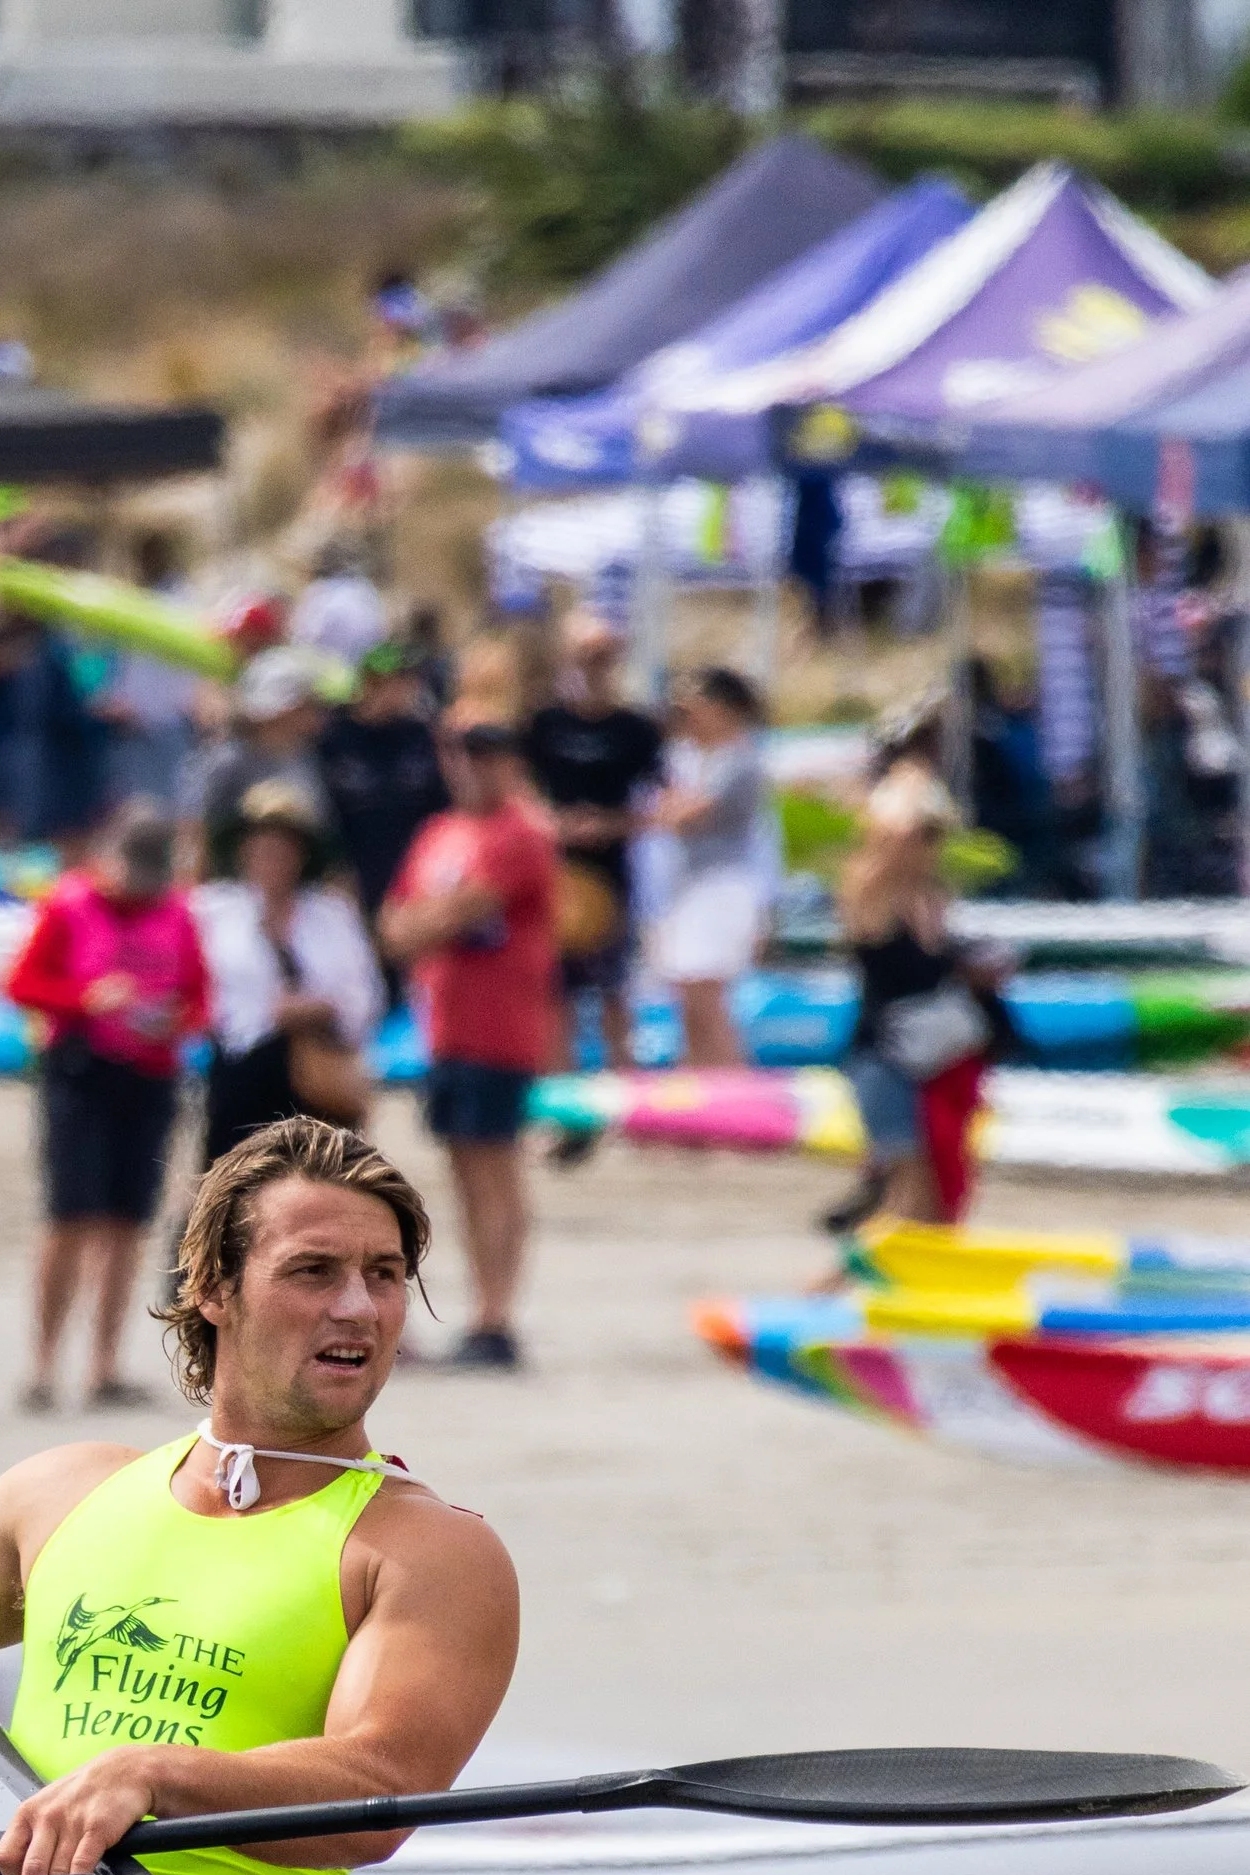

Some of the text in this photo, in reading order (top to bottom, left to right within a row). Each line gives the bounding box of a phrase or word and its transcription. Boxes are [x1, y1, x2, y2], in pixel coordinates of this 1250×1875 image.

[173, 1633, 246, 1677] THE
[90, 1653, 228, 1720] Flying
[62, 1701, 204, 1747] Herons
